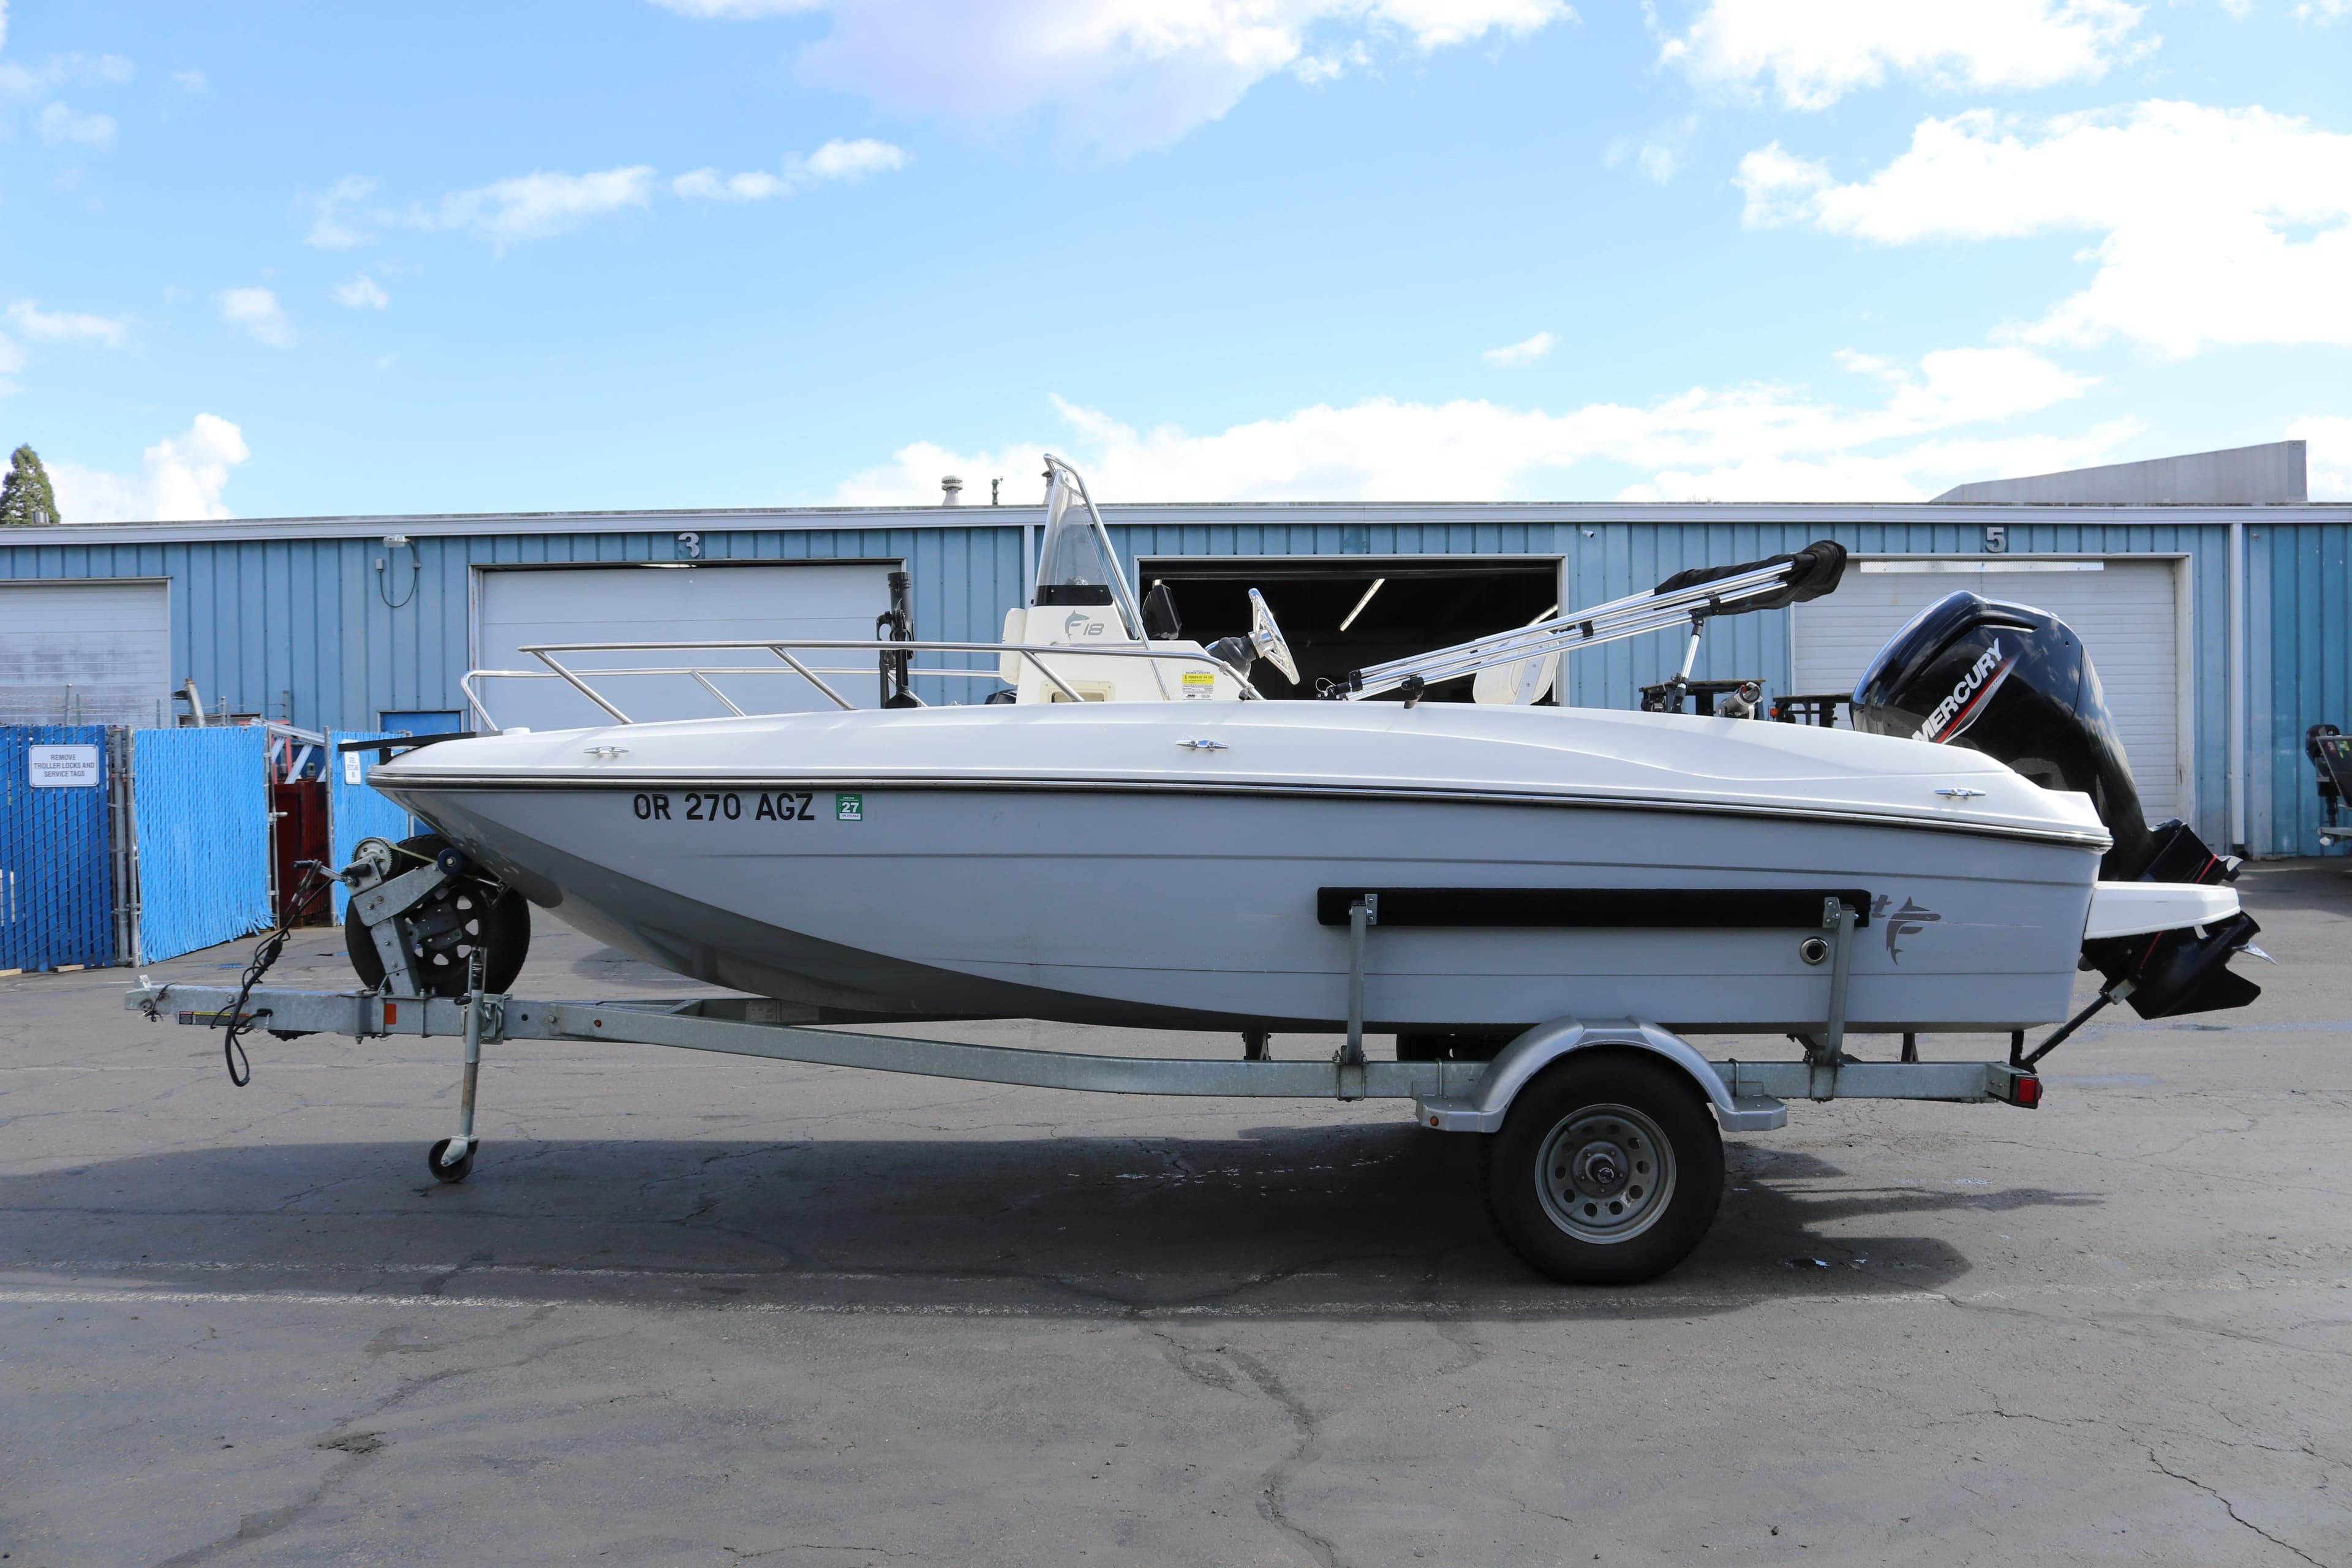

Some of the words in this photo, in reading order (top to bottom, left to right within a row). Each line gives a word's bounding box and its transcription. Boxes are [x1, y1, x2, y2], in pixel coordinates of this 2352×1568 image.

[678, 532, 699, 557] 3
[1986, 527, 2006, 552] 5
[1912, 638, 2002, 742] MERCURY
[634, 793, 672, 820] OR
[685, 793, 741, 821] 270
[755, 793, 815, 821] AGZ
[842, 802, 859, 813] 27
